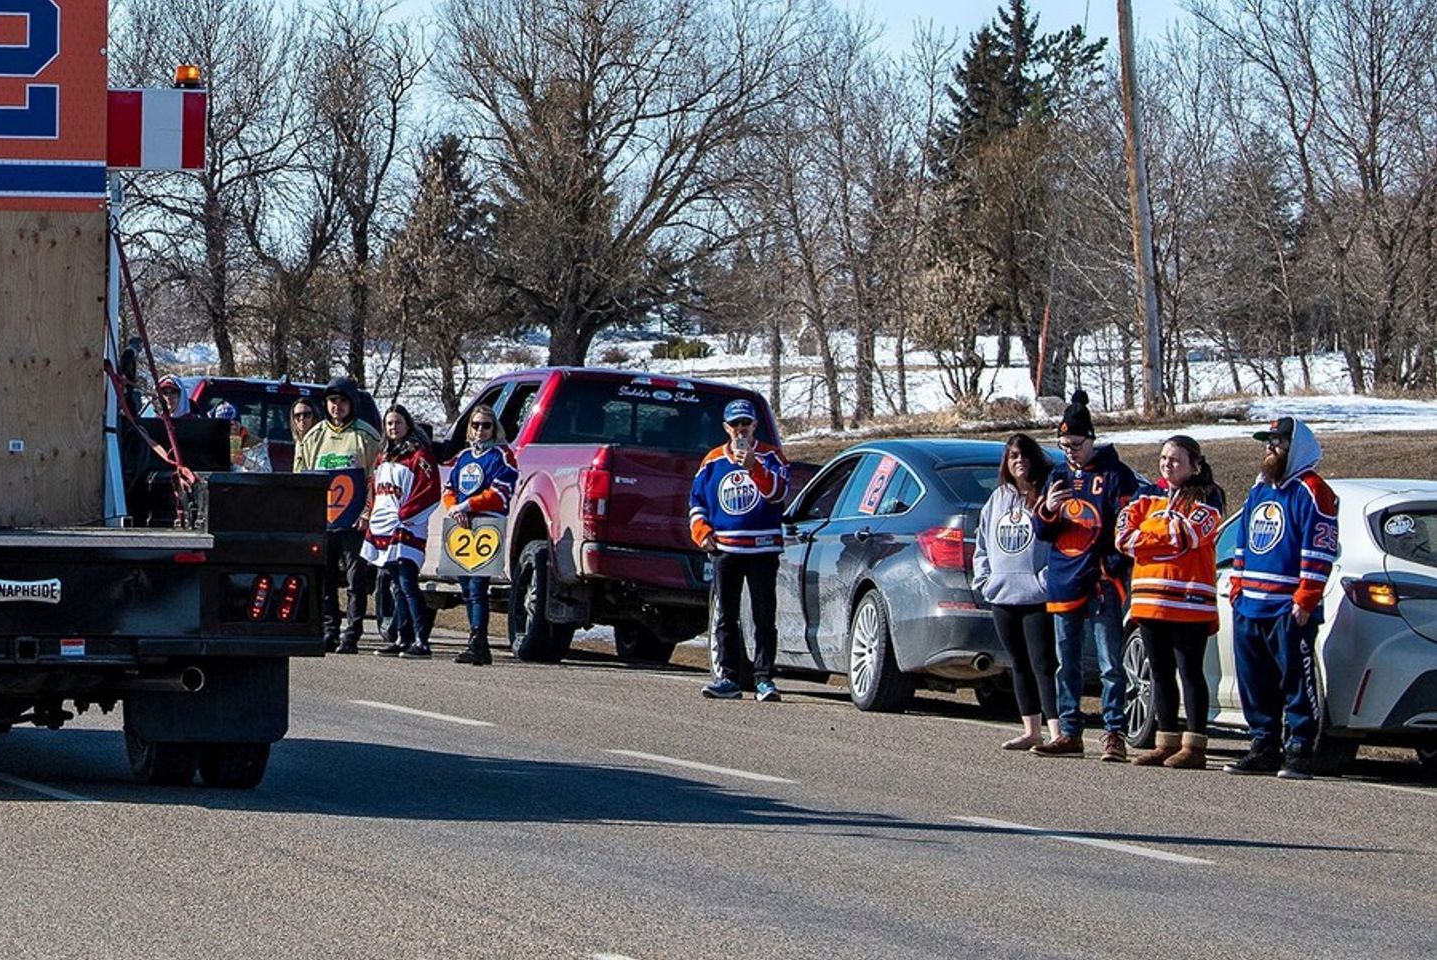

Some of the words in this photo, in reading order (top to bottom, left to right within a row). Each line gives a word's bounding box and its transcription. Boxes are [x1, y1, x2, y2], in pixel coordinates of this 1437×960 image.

[1092, 475, 1103, 495] C
[455, 534, 492, 557] 26
[1314, 522, 1339, 553] 25
